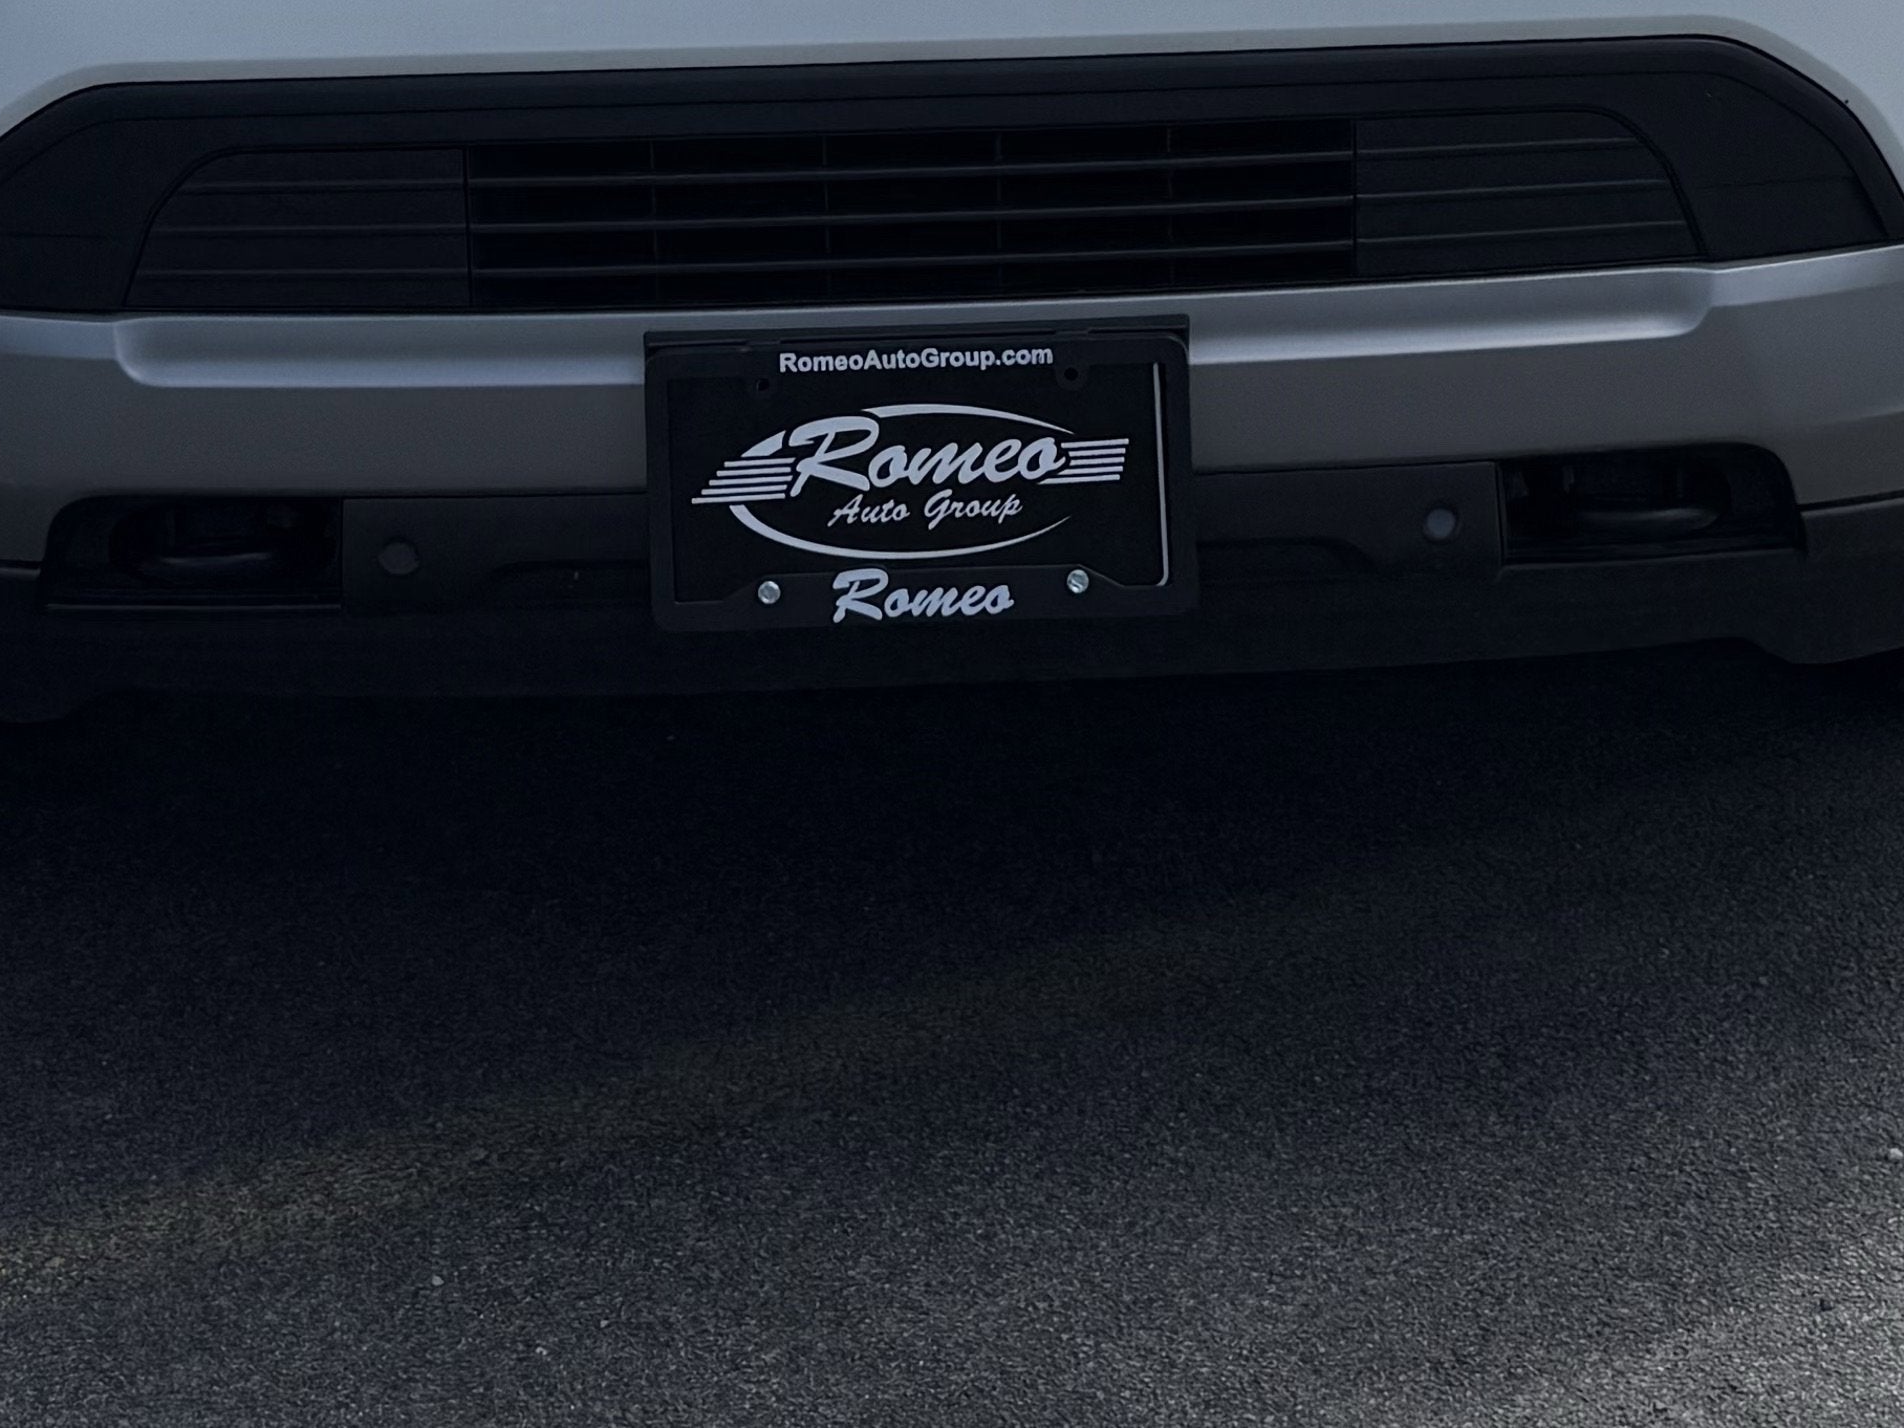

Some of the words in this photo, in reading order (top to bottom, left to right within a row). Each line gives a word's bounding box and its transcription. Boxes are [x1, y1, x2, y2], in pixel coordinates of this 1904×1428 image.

[778, 347, 1054, 374] RomeoAutoGroup.com
[788, 415, 1068, 498] Romeo
[827, 493, 910, 528] Auto
[923, 490, 1023, 531] Group
[832, 567, 1015, 624] Romeo
